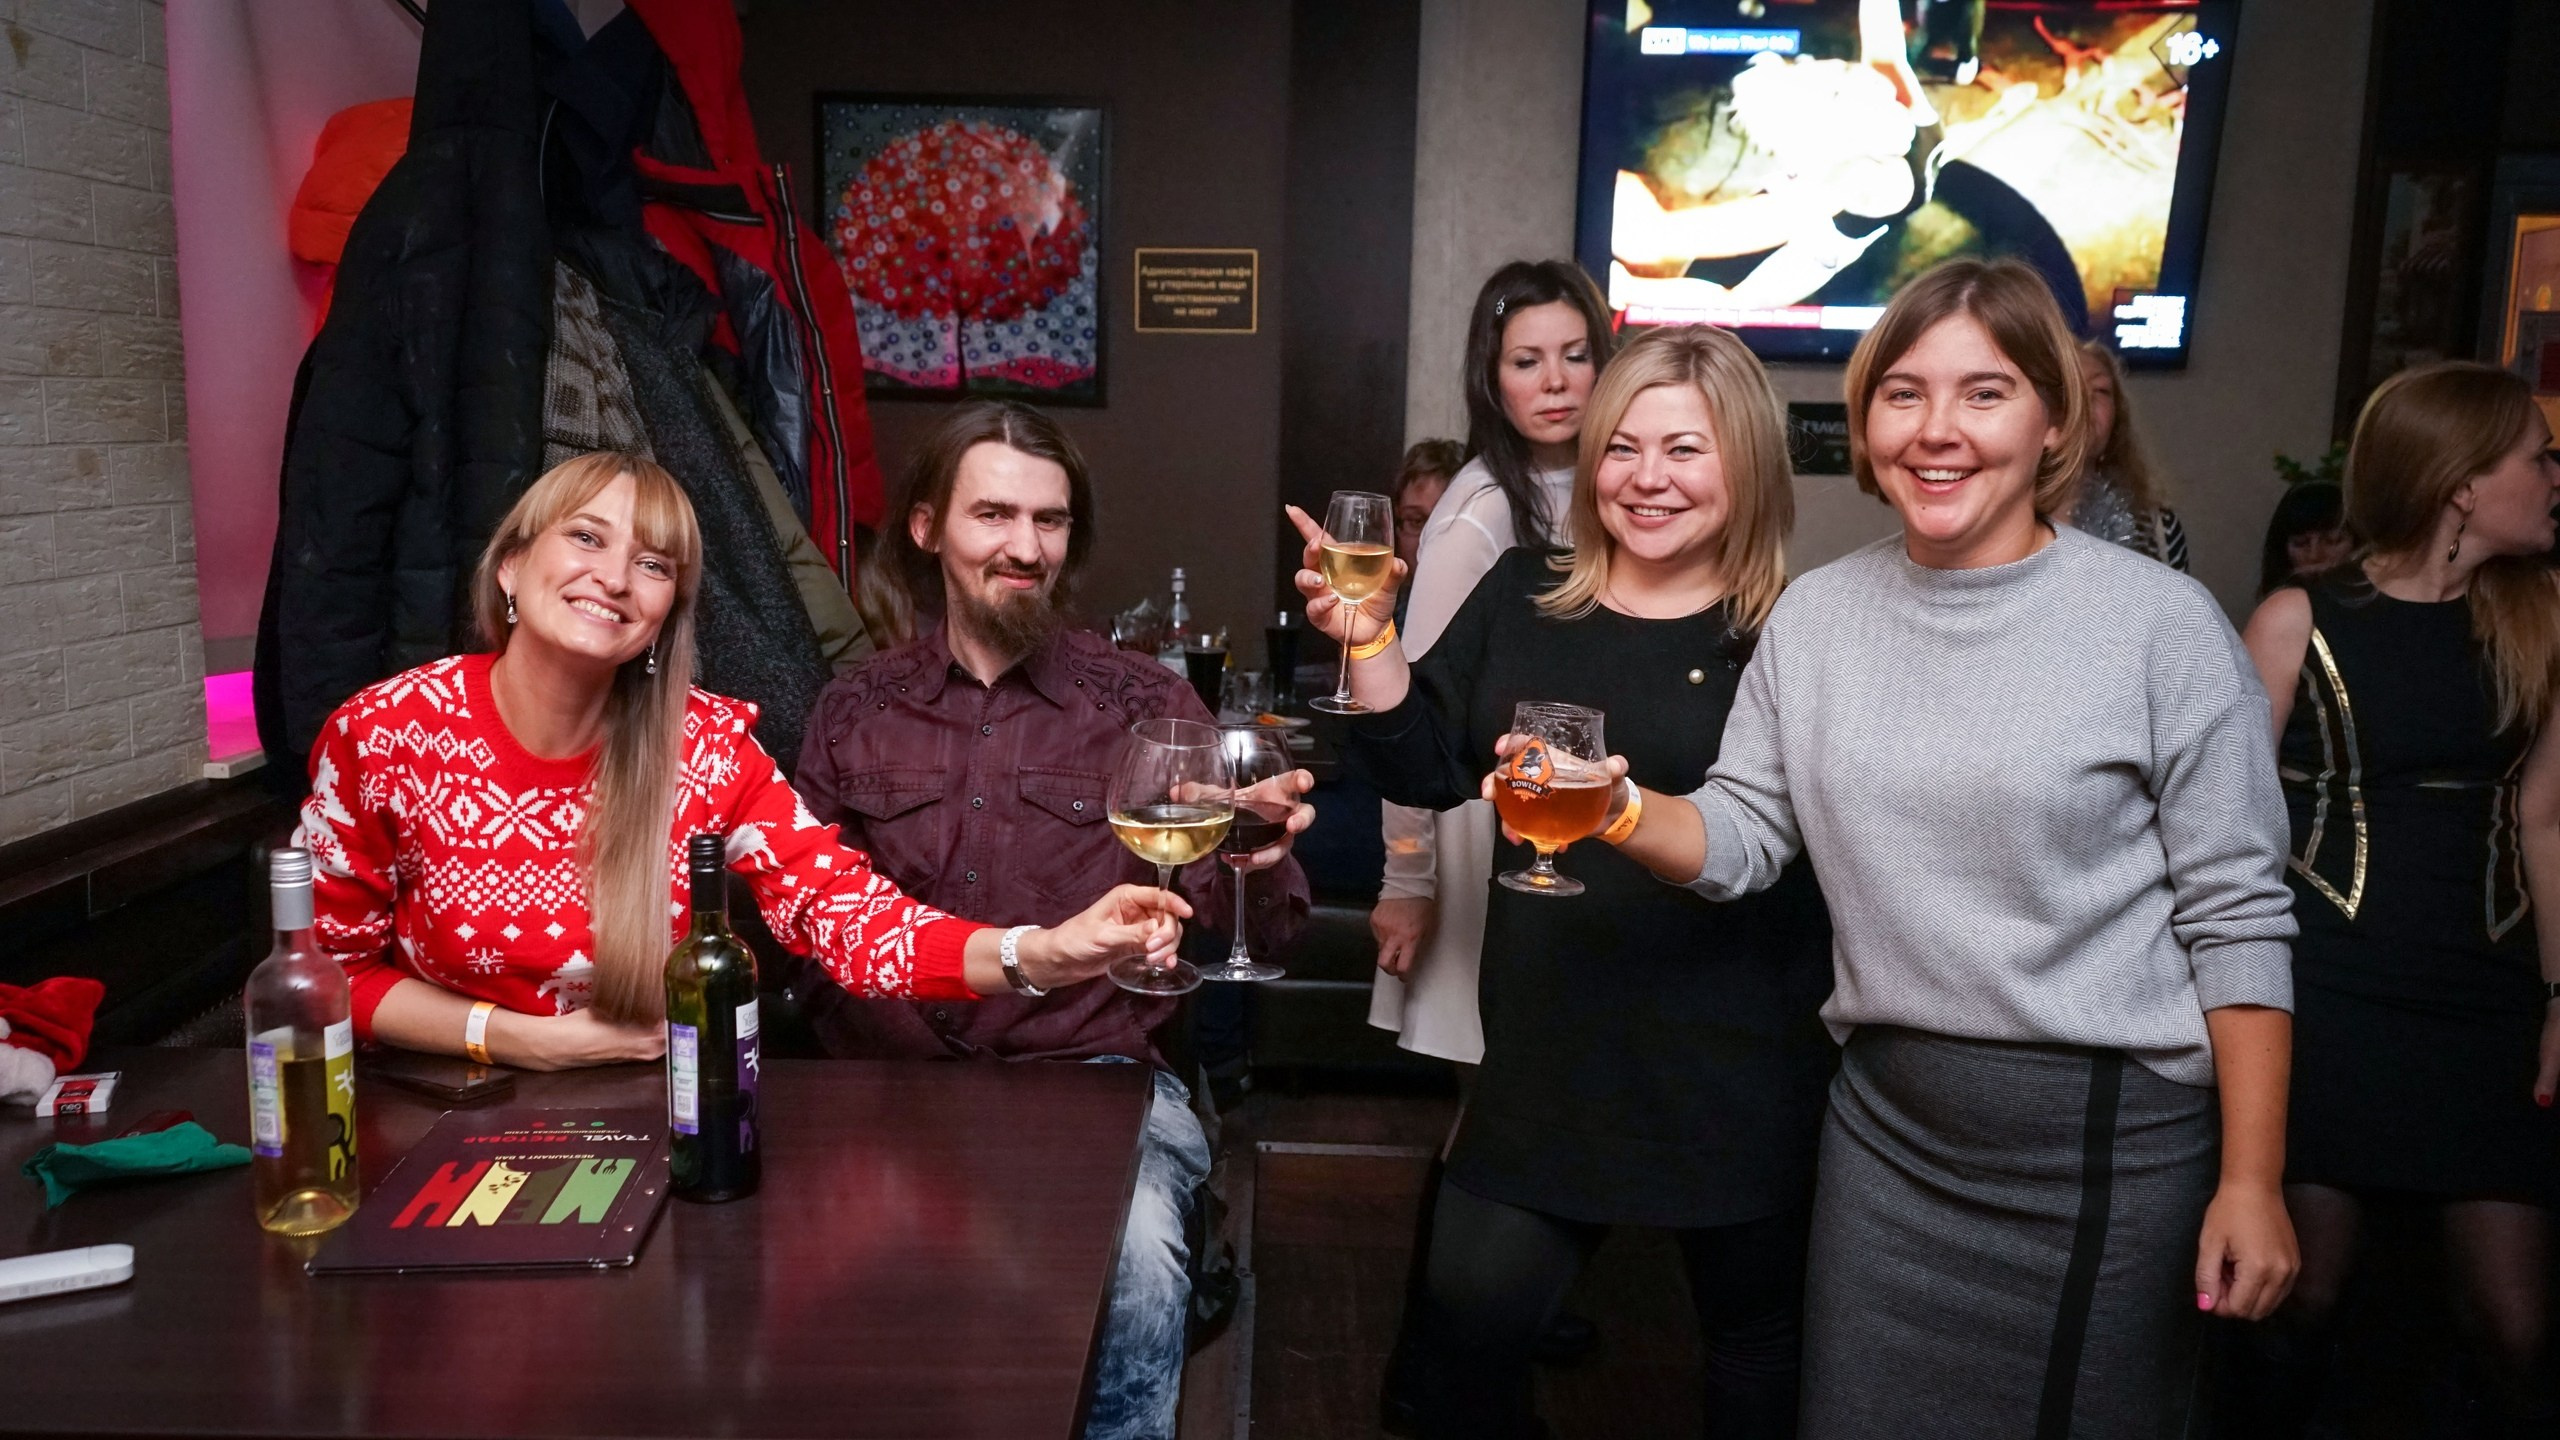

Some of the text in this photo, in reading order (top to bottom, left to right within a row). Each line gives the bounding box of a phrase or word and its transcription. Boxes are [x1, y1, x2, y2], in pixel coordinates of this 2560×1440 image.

[2166, 31, 2220, 66] 16+
[1141, 265, 1252, 278] Администрация кафе
[1218, 281, 1247, 291] вещи
[1152, 294, 1240, 304] ответственности
[1173, 307, 1187, 317] не
[1511, 780, 1542, 794] BOWLER
[463, 1135, 568, 1144] РЕСТОБАР
[583, 1134, 651, 1142] TRAVEL
